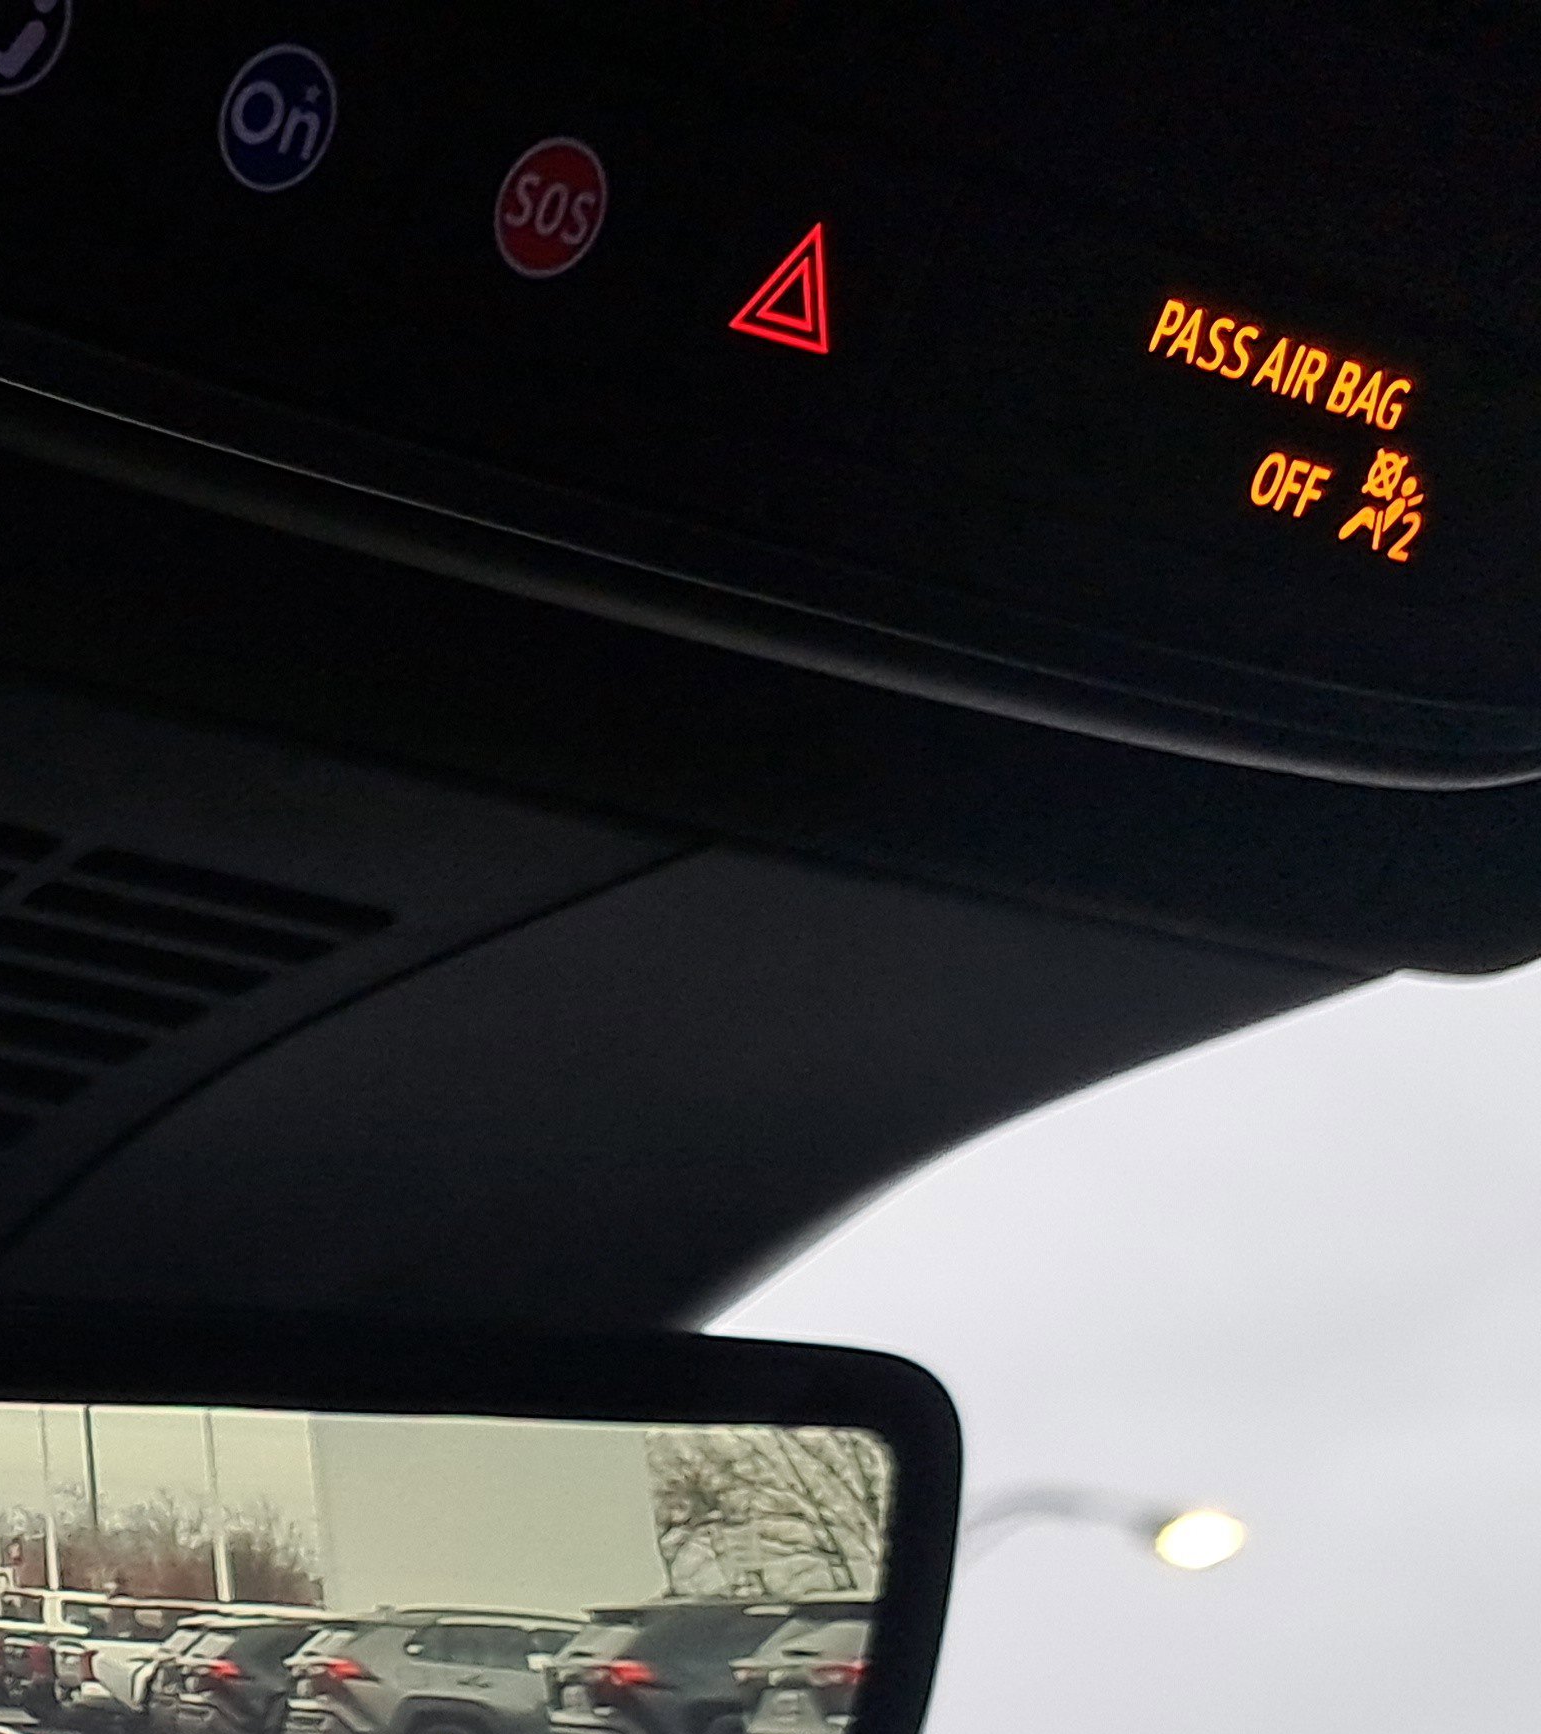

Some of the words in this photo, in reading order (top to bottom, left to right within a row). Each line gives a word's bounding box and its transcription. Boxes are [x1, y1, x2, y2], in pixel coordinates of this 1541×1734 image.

[231, 80, 321, 161] On
[505, 173, 596, 246] SOS
[1148, 299, 1260, 380] PASS
[1251, 337, 1328, 405] AIR
[1325, 360, 1411, 431] BAG
[1250, 452, 1332, 518] OFF
